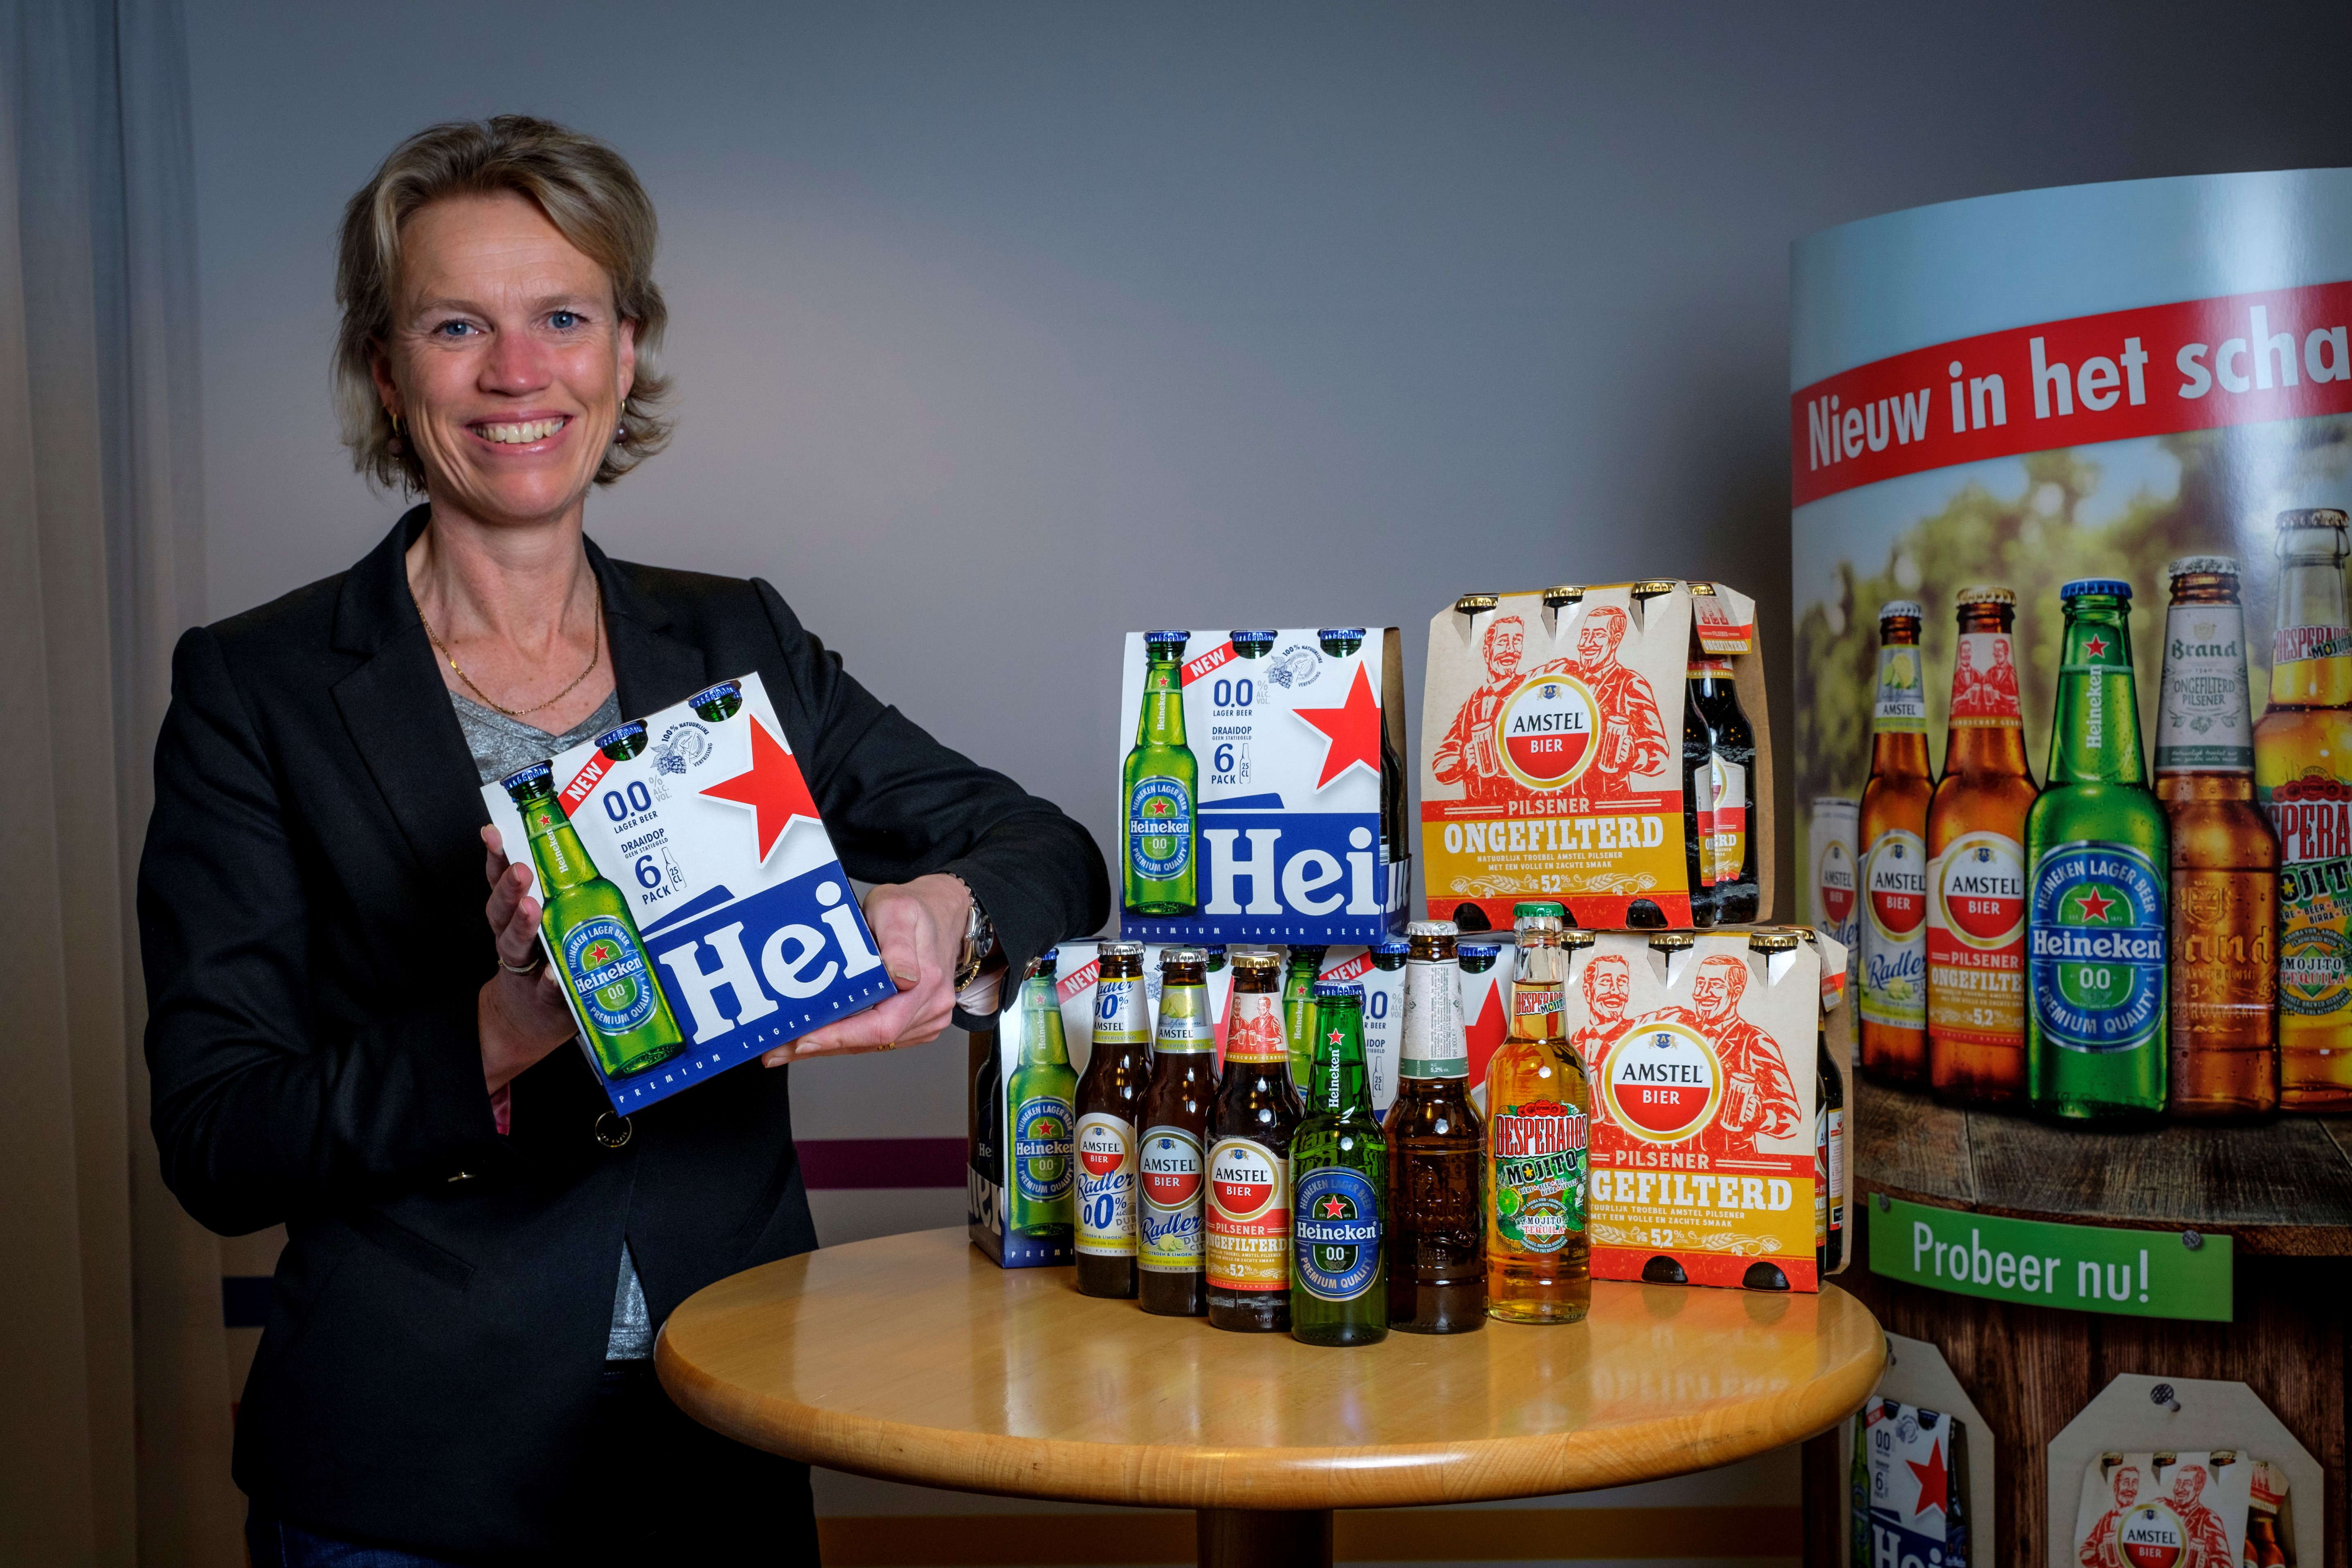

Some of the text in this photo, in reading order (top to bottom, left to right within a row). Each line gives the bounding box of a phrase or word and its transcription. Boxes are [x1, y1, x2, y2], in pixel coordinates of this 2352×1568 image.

[1808, 304, 2352, 471] Nieuw in het scha
[2171, 638, 2237, 661] Brand
[1189, 648, 1225, 677] NEW
[1298, 671, 1321, 687] VERFRISSING
[2174, 676, 2235, 694] ONGEFILTERD
[1214, 678, 1253, 708] 0.0
[2182, 694, 2226, 706] PILSENER
[1157, 689, 1167, 731] Heineken
[1883, 704, 1916, 715] AMSTEL
[2086, 664, 2102, 748] Heineken
[679, 722, 710, 735] NATUURLIJKE
[1212, 727, 1252, 735] DRAAIDOP
[1513, 713, 1582, 733] AMSTEL
[693, 743, 713, 767] VERFRISSING
[1530, 738, 1563, 753] BIER
[1214, 743, 1234, 773] 6
[567, 762, 603, 801] NEW
[1212, 775, 1236, 785] PACK
[653, 785, 670, 796] ALC.
[655, 792, 672, 802] VOL.
[1133, 784, 1178, 811] HEINEKEN LAGER
[602, 781, 652, 821] 0.0
[1508, 798, 1590, 816] PILSENER
[614, 811, 658, 834] LAGER BEER
[1131, 819, 1189, 834] Heineken
[621, 828, 664, 853] DRAAIDOP
[1151, 837, 1167, 850] 0.0
[1444, 816, 1664, 854] ONGEFILTERD
[546, 829, 569, 874] Heineken
[625, 837, 668, 859] GEEN STATIEGELD
[1133, 847, 1187, 872] PREMIUM QUALITY
[1477, 854, 1521, 863] NATUURLIJK
[634, 854, 661, 889] 6
[670, 866, 679, 876] 25
[673, 875, 683, 884] CL
[1203, 827, 1382, 916] Hei
[1824, 871, 1852, 887] AMSTEL
[1875, 872, 1926, 891] AMSTEL
[1952, 876, 2020, 895] AMSTEL
[2038, 860, 2156, 914] HEINEKEN LAGER BEER
[642, 885, 672, 905] PACK
[1830, 891, 1844, 903] BIER
[1887, 896, 1910, 910] BIER
[1968, 900, 2000, 915] BIER
[2304, 897, 2351, 916] BEER BIER
[2309, 911, 2334, 924] BIRRA
[1128, 926, 1375, 936] PREMIUM LAGER BEER
[569, 925, 630, 968] HEINEKEN LAGER BEER
[2033, 929, 2162, 959] Heineken
[659, 881, 882, 1045] Hei
[1951, 952, 2018, 968] PILSENER
[2285, 958, 2342, 970] MOJITO
[574, 957, 643, 994] Heineken
[1064, 964, 1099, 994] NEW
[2080, 967, 2111, 990] 0.0
[2280, 971, 2346, 984] TEQUILA
[607, 983, 625, 1000] 0.0
[590, 984, 649, 1025] PREMIUM QUALITY
[2038, 985, 2097, 1034] PREMIUM
[2103, 988, 2156, 1034] QUALITY
[1094, 1022, 1123, 1031] AMSTEL
[1294, 998, 1304, 1039] Heineken
[1038, 1008, 1047, 1049] Heineken
[1158, 1029, 1192, 1038] AMSTEL
[619, 982, 885, 1103] PREMIUM LAGER BEER
[1329, 1049, 1340, 1108] Heineken
[1621, 1064, 1702, 1083] AMSTEL
[1643, 1089, 1680, 1105] BIER
[1018, 1105, 1064, 1133] HEINEKEN LAGER
[1496, 1115, 1587, 1156] DESPERADOS
[1082, 1141, 1120, 1152] AMSTEL
[1039, 1159, 1054, 1170] 0.0
[1090, 1155, 1108, 1163] BIER
[1144, 1157, 1196, 1172] AMSTEL
[1506, 1150, 1577, 1186] MOJITO
[1615, 1150, 1709, 1170] PILSENER
[1019, 1168, 1073, 1193] PREMIUM QUALITY
[1154, 1177, 1180, 1187] BIER
[1215, 1168, 1267, 1182] AMSTEL
[1077, 1170, 1136, 1202] Radler
[1227, 1186, 1251, 1197] BIER
[1300, 1179, 1372, 1210] HEINEKEN LAGER BEER
[1541, 1179, 1578, 1196] BIRRA CERVEZA
[1084, 1193, 1114, 1230] 0.0
[1527, 1217, 1562, 1225] MOJITO
[1631, 1206, 1745, 1219] TROEBEL AMSTEL PILSENER
[1140, 1213, 1201, 1246] Radler
[1216, 1222, 1265, 1235] PILSENER
[1297, 1221, 1376, 1241] Heineken
[1524, 1226, 1565, 1234] TEQUILA
[1668, 1217, 1700, 1226] ZACHTE
[1205, 1234, 1287, 1252] ONGEFILTERD
[1326, 1246, 1345, 1261] 0.0
[1914, 1221, 2150, 1303] Probeer nu!
[1301, 1256, 1372, 1289] PREMIUM QUALITY
[2127, 1529, 2175, 1545] AMSTEL
[2139, 1547, 2162, 1558] BIER
